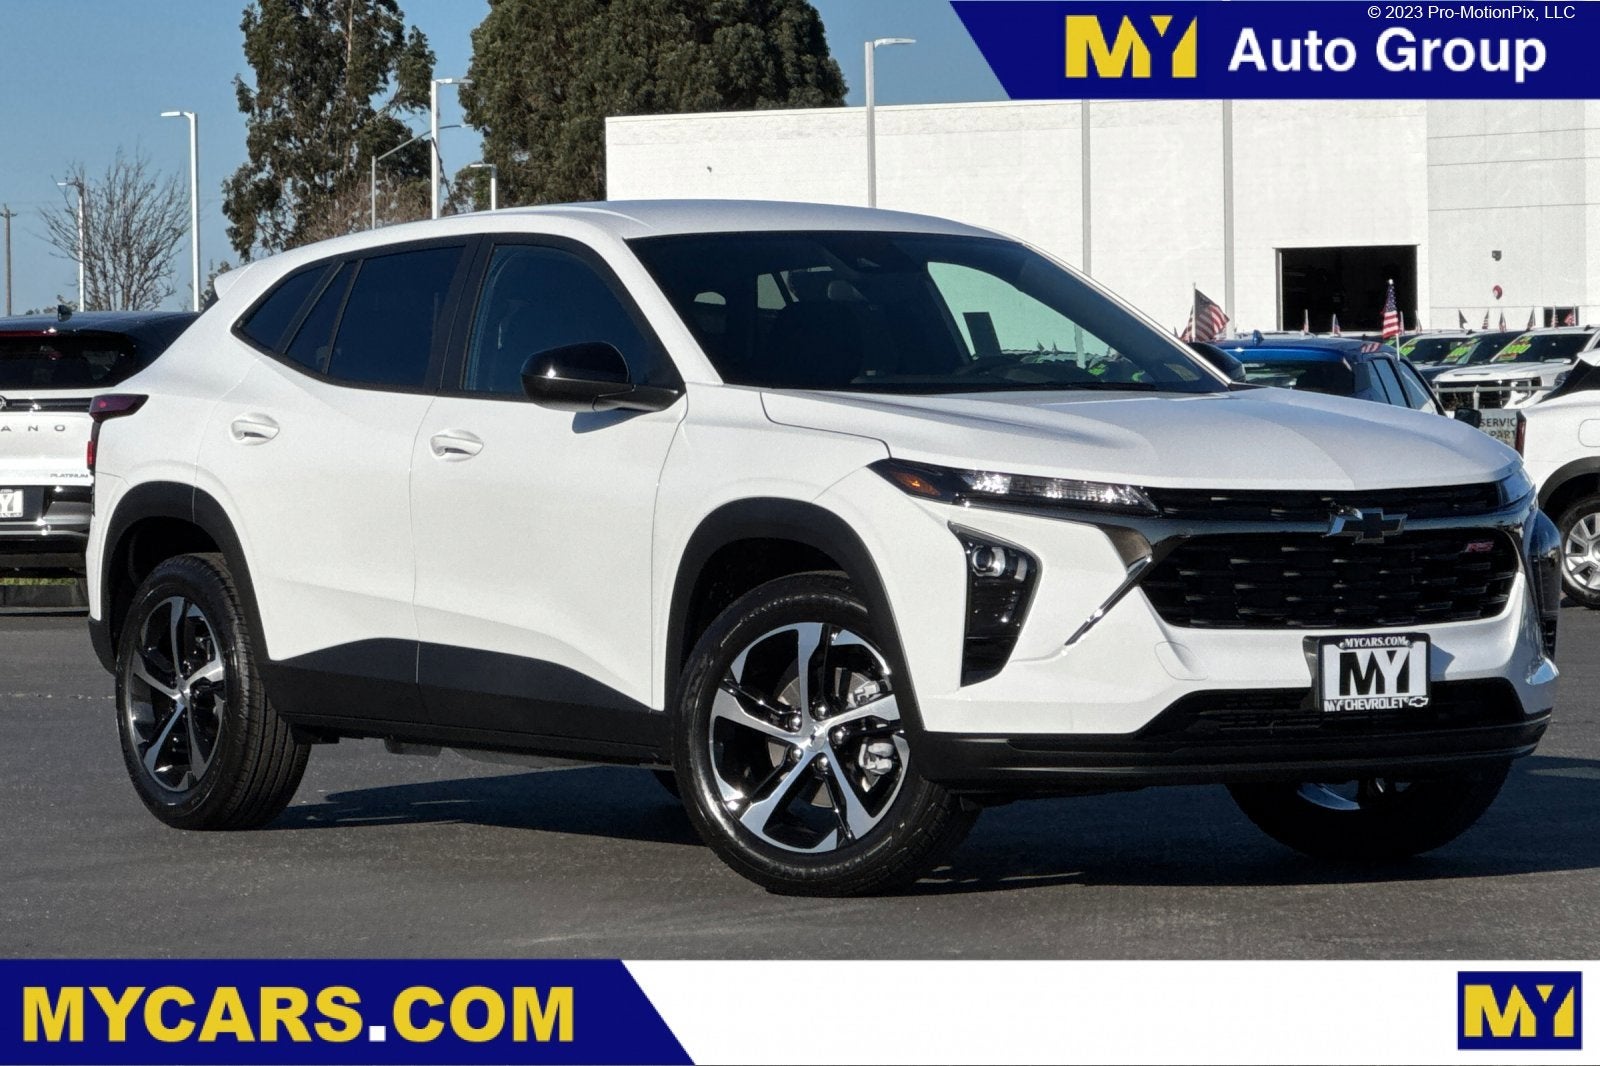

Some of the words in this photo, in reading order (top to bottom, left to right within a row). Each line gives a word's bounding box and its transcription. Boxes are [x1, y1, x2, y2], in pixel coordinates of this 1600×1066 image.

[1345, 636, 1407, 648] MYCARS.COM
[1339, 650, 1410, 696] MY
[1344, 697, 1404, 711] CHEVROLET
